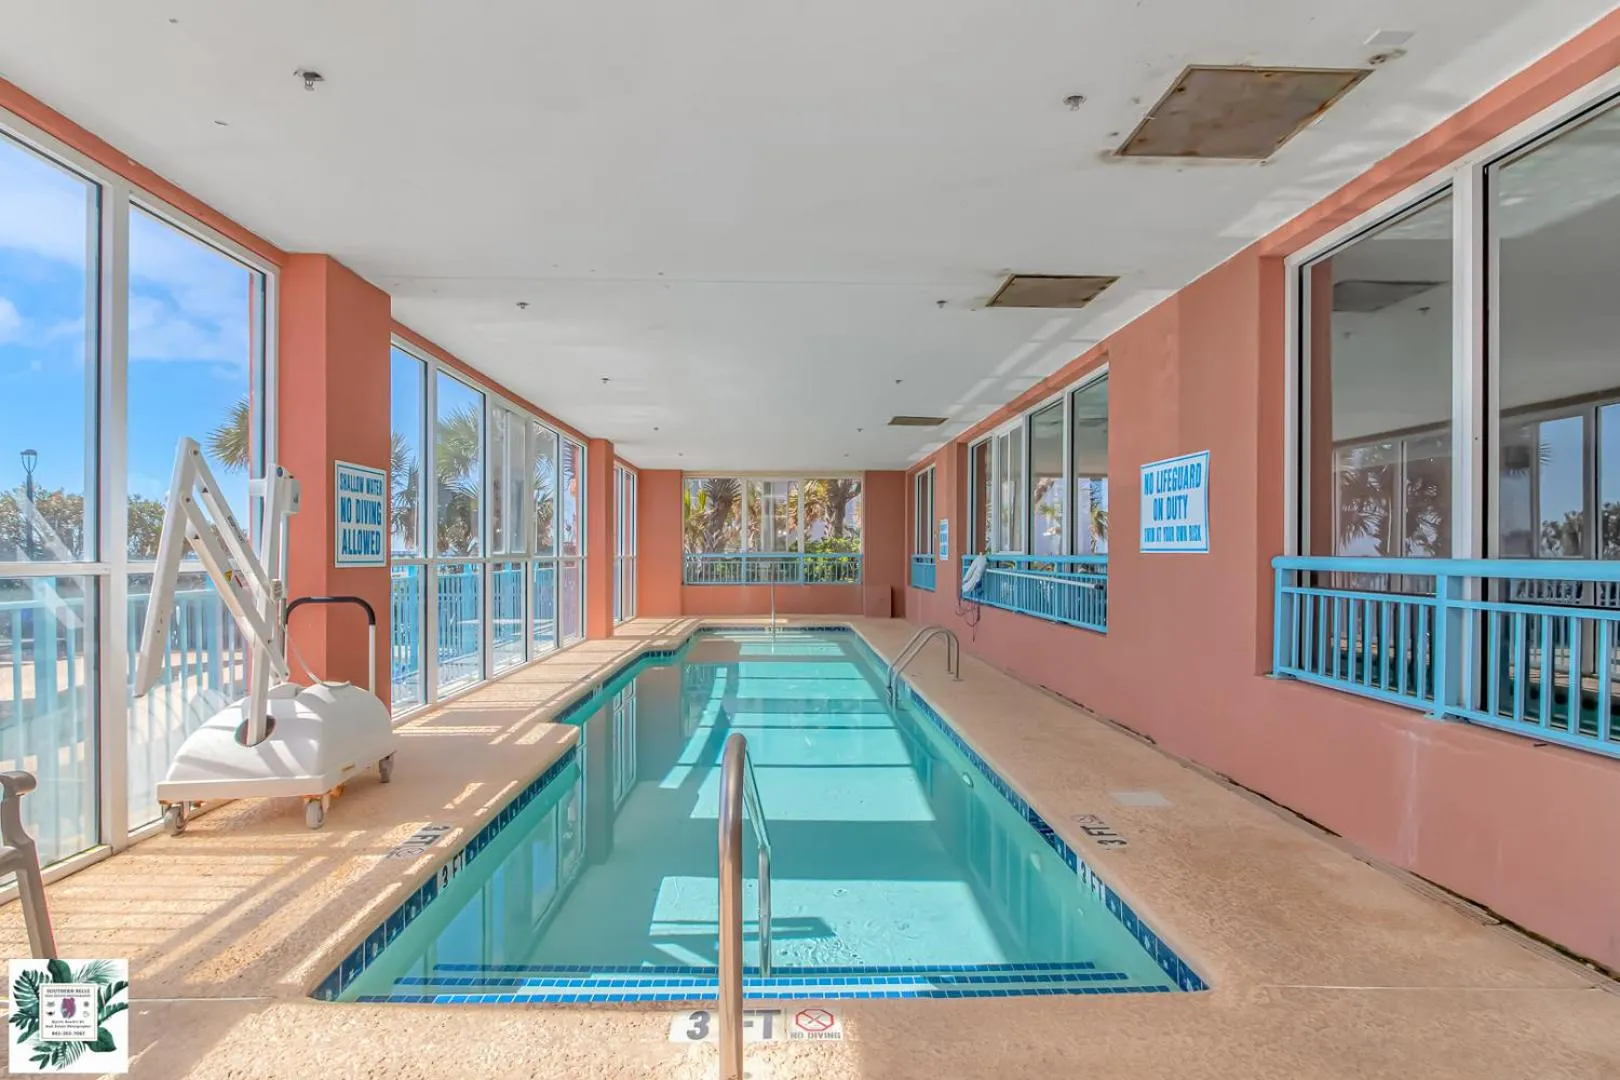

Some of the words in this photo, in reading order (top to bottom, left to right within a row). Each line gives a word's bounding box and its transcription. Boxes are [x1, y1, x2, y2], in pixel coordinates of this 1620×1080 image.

[340, 473, 364, 493] SHALLOW
[365, 478, 383, 496] WATER
[1144, 472, 1154, 496] NO
[1156, 463, 1202, 494] LIFEGUARD
[340, 496, 352, 523] NO
[356, 498, 382, 526] DIVING
[1153, 497, 1163, 521] ON
[1166, 494, 1189, 520] DUTY
[341, 528, 381, 555] ALLOWED
[1080, 826, 1118, 836] FT
[442, 864, 449, 889] 3
[452, 849, 465, 879] FT
[1090, 869, 1103, 901] FT
[686, 1010, 711, 1041] 3
